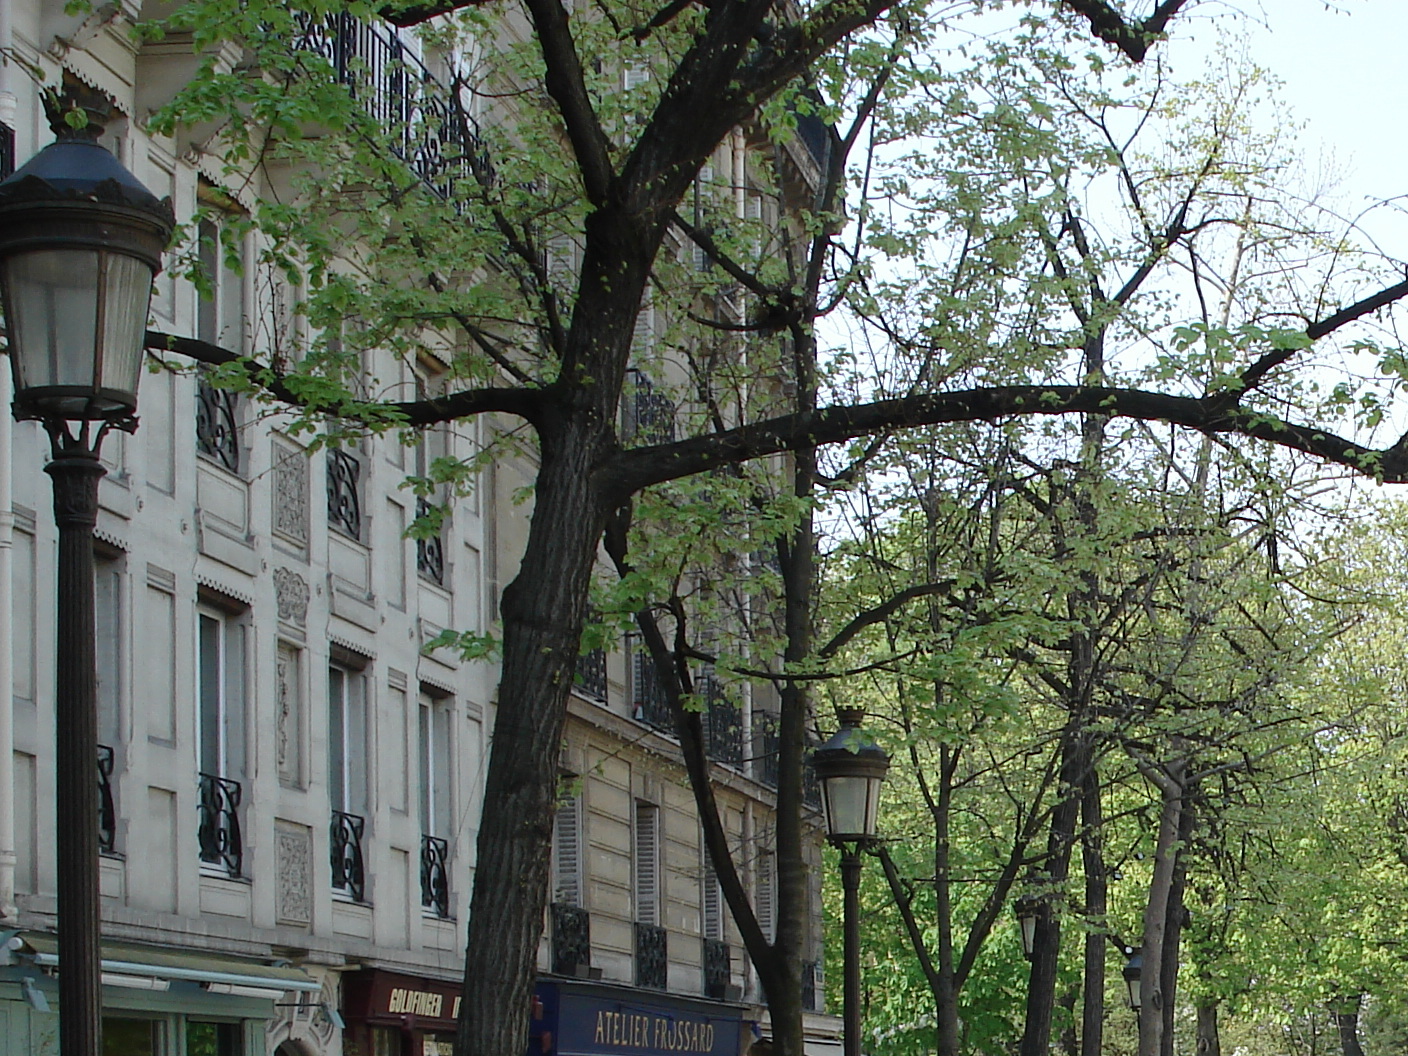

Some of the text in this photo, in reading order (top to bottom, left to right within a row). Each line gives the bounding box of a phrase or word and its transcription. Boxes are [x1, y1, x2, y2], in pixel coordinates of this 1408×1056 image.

[388, 988, 443, 1018] GOLDFINGER
[595, 1010, 714, 1053] ATELIER FROSSARD
